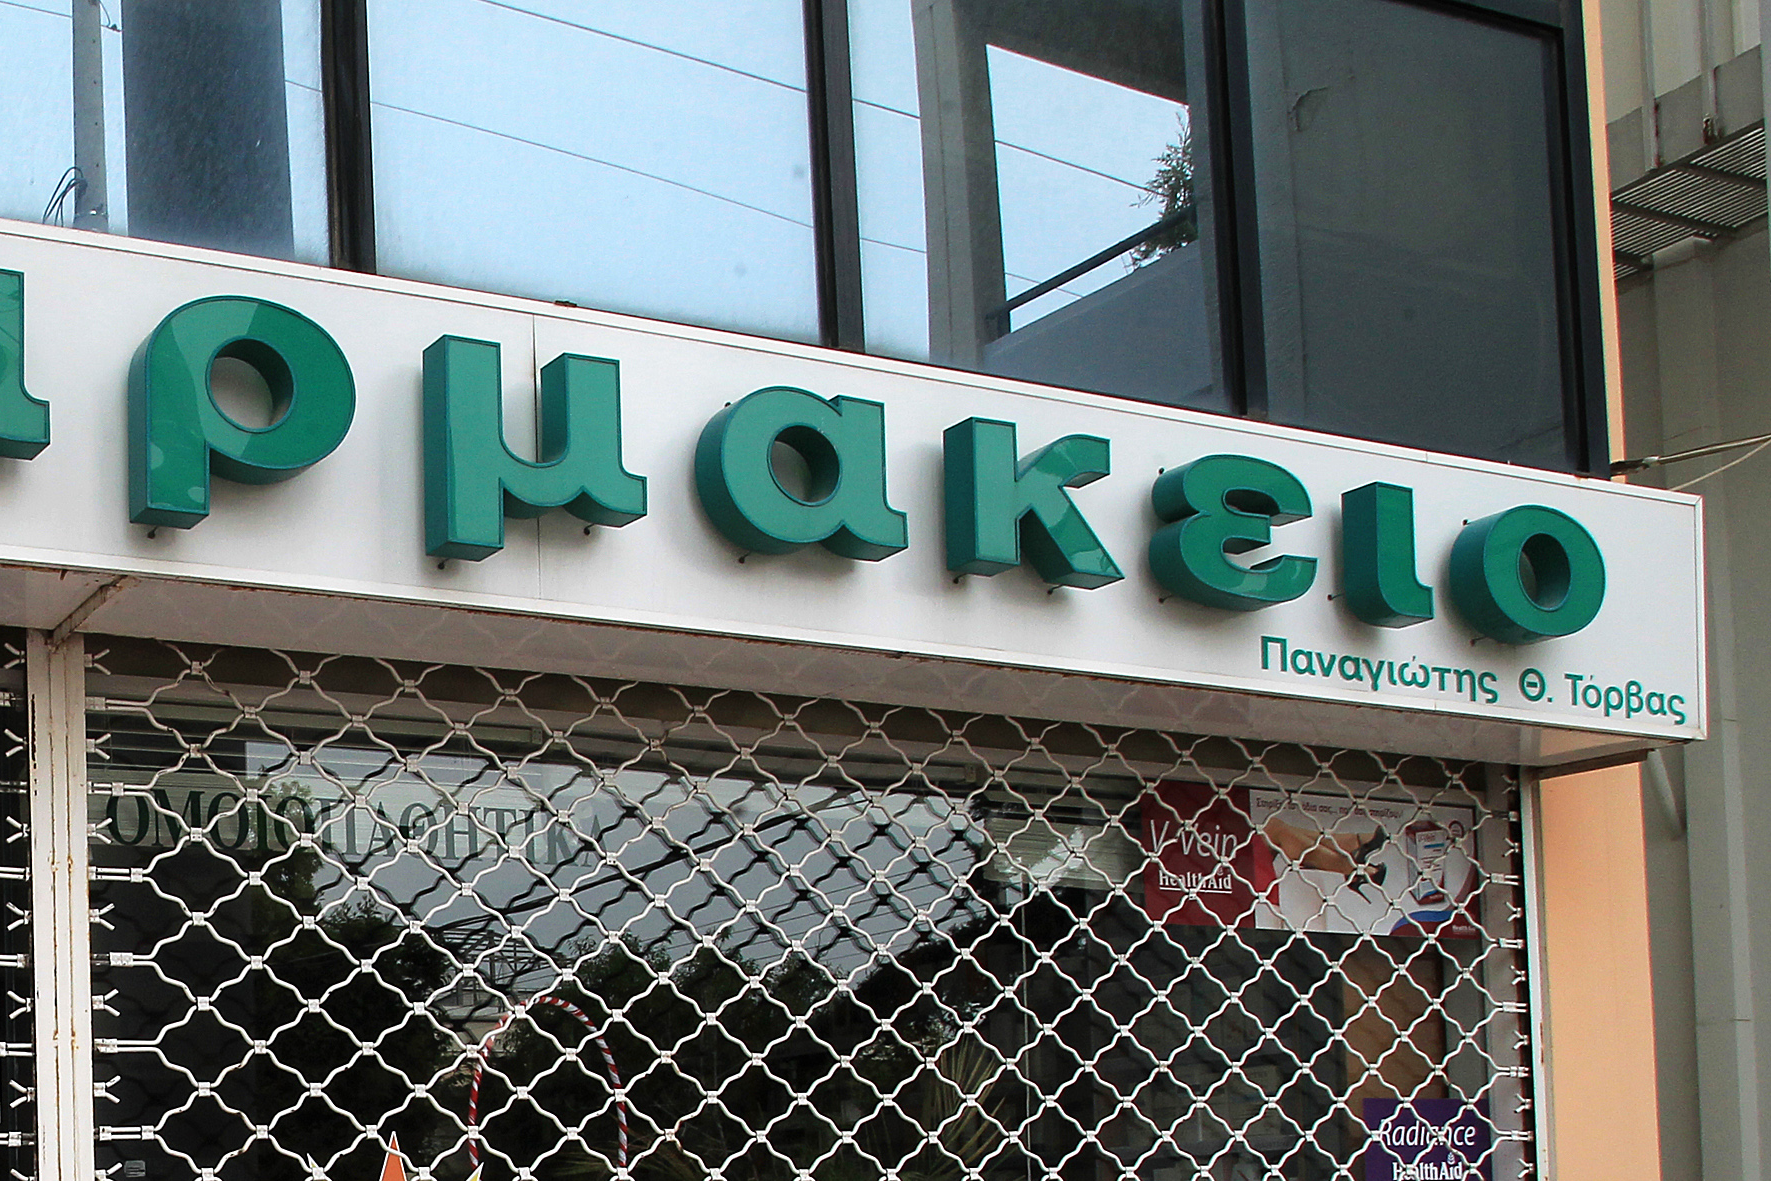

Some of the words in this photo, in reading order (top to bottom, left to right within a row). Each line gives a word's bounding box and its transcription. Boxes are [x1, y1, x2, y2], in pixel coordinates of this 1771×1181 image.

[1259, 635, 1499, 704] Παναγιώτης
[1518, 667, 1553, 703] Θ.
[1564, 672, 1687, 726] Τόρβας
